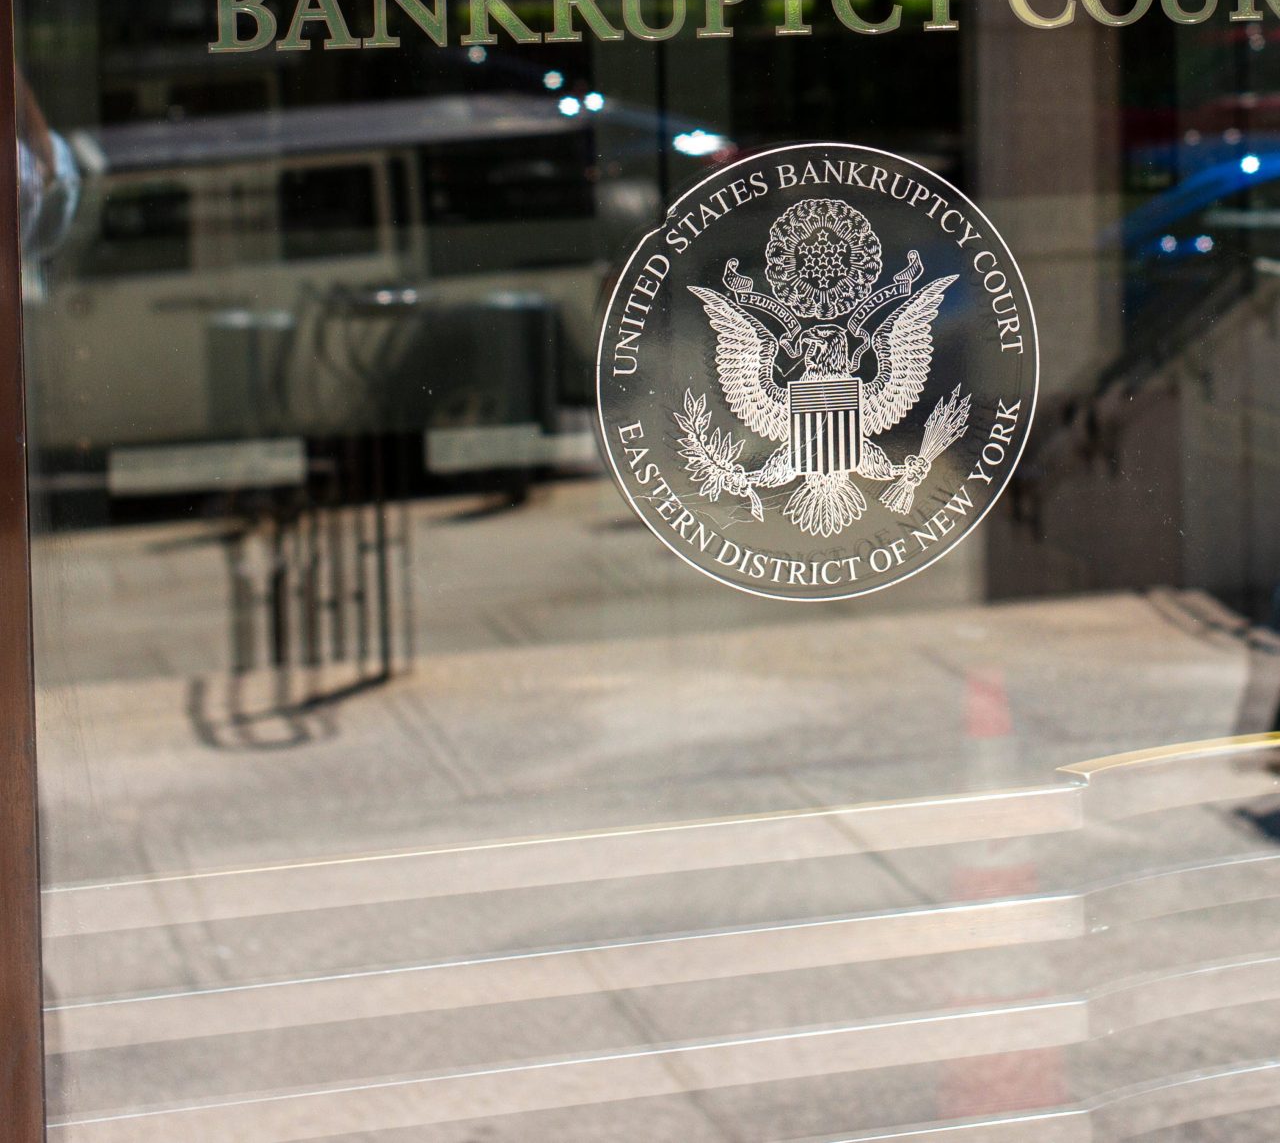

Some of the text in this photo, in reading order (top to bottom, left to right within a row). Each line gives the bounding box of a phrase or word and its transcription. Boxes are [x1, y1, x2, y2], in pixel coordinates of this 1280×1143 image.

[613, 159, 1024, 377] UNITED STATES BANKRUPTCY COURT
[748, 295, 797, 329] PLURIBUS
[855, 287, 898, 323] UNUM
[617, 397, 1022, 586] EASTERN DISTRICT OF NEW YORK
